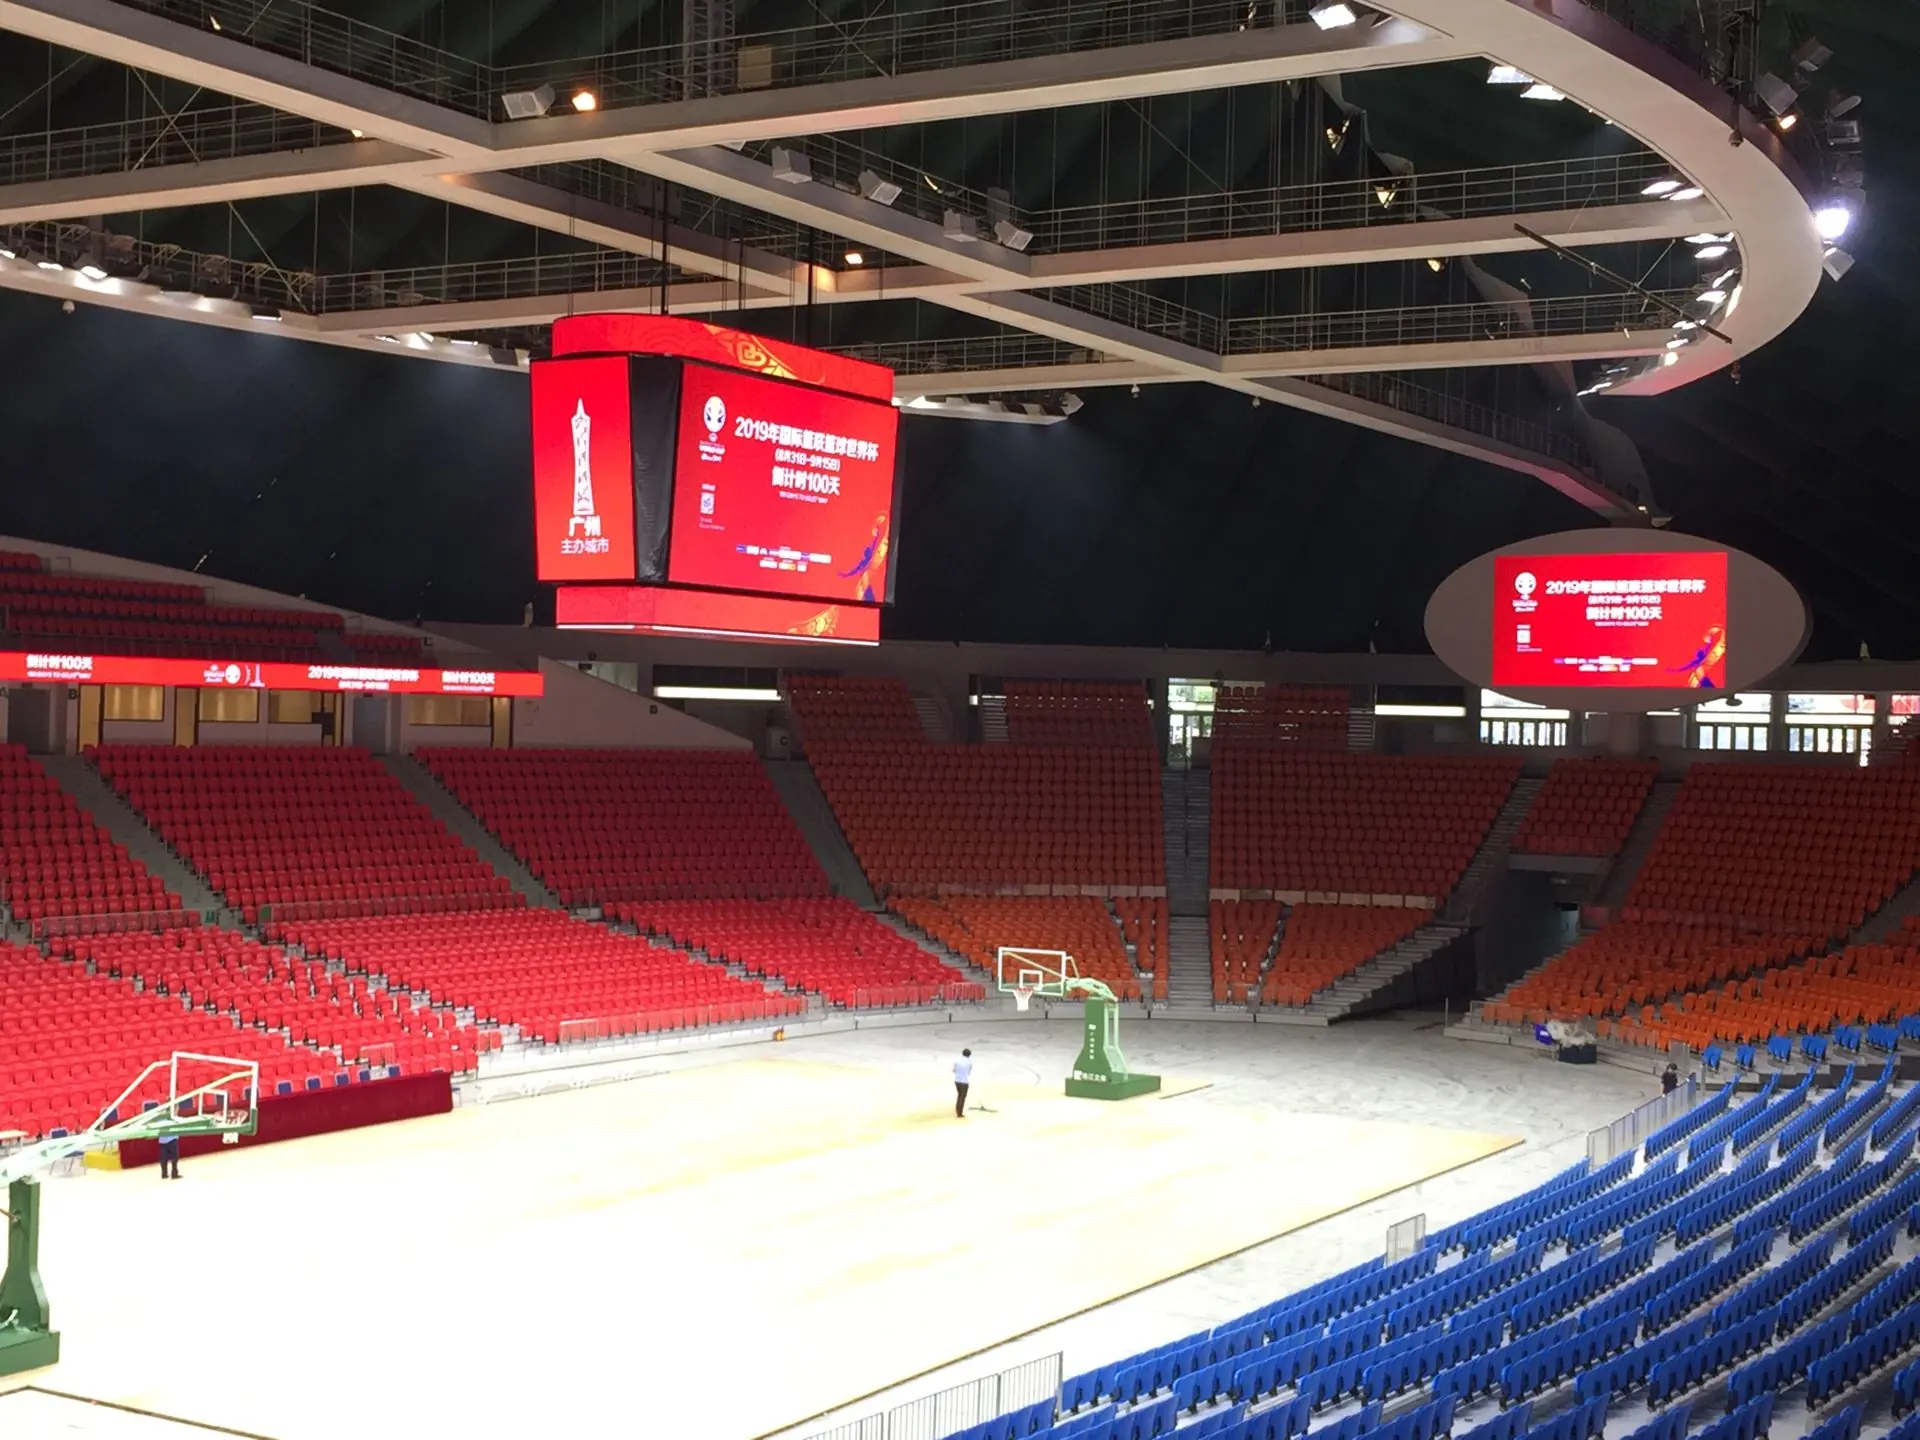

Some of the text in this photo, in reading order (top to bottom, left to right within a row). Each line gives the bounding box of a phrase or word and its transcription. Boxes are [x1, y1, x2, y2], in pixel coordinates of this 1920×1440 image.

[772, 466, 841, 496] 倒计时100天
[568, 515, 602, 537] 广州
[560, 538, 610, 554] 主办城市
